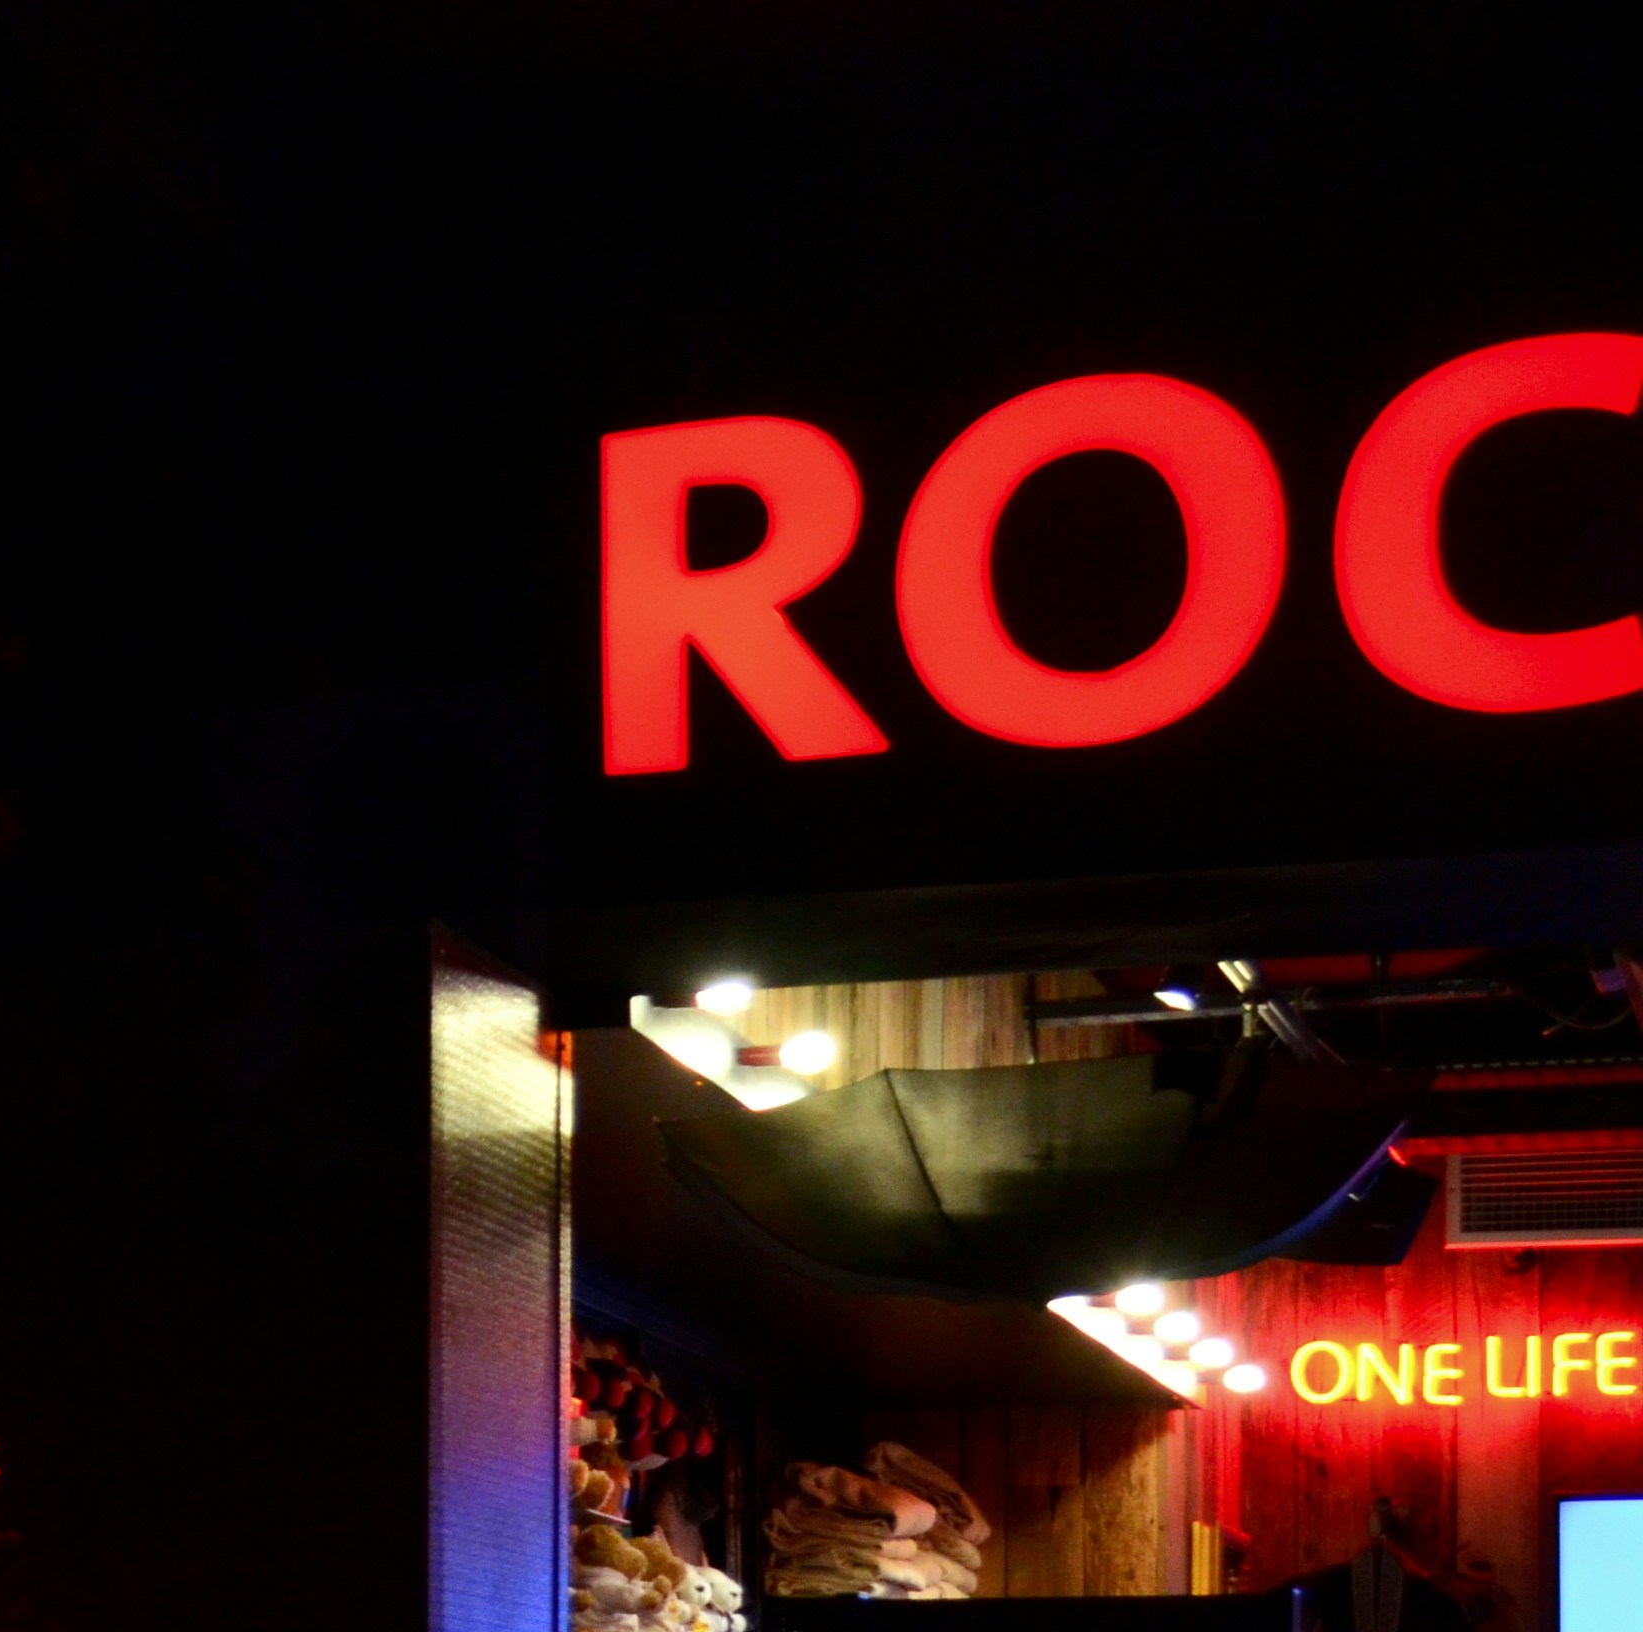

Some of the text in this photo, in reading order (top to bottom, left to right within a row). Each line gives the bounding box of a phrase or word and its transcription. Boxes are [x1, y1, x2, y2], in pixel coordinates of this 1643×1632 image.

[600, 332, 1643, 776] ROC
[1289, 1331, 1638, 1406] ONE LIFE
